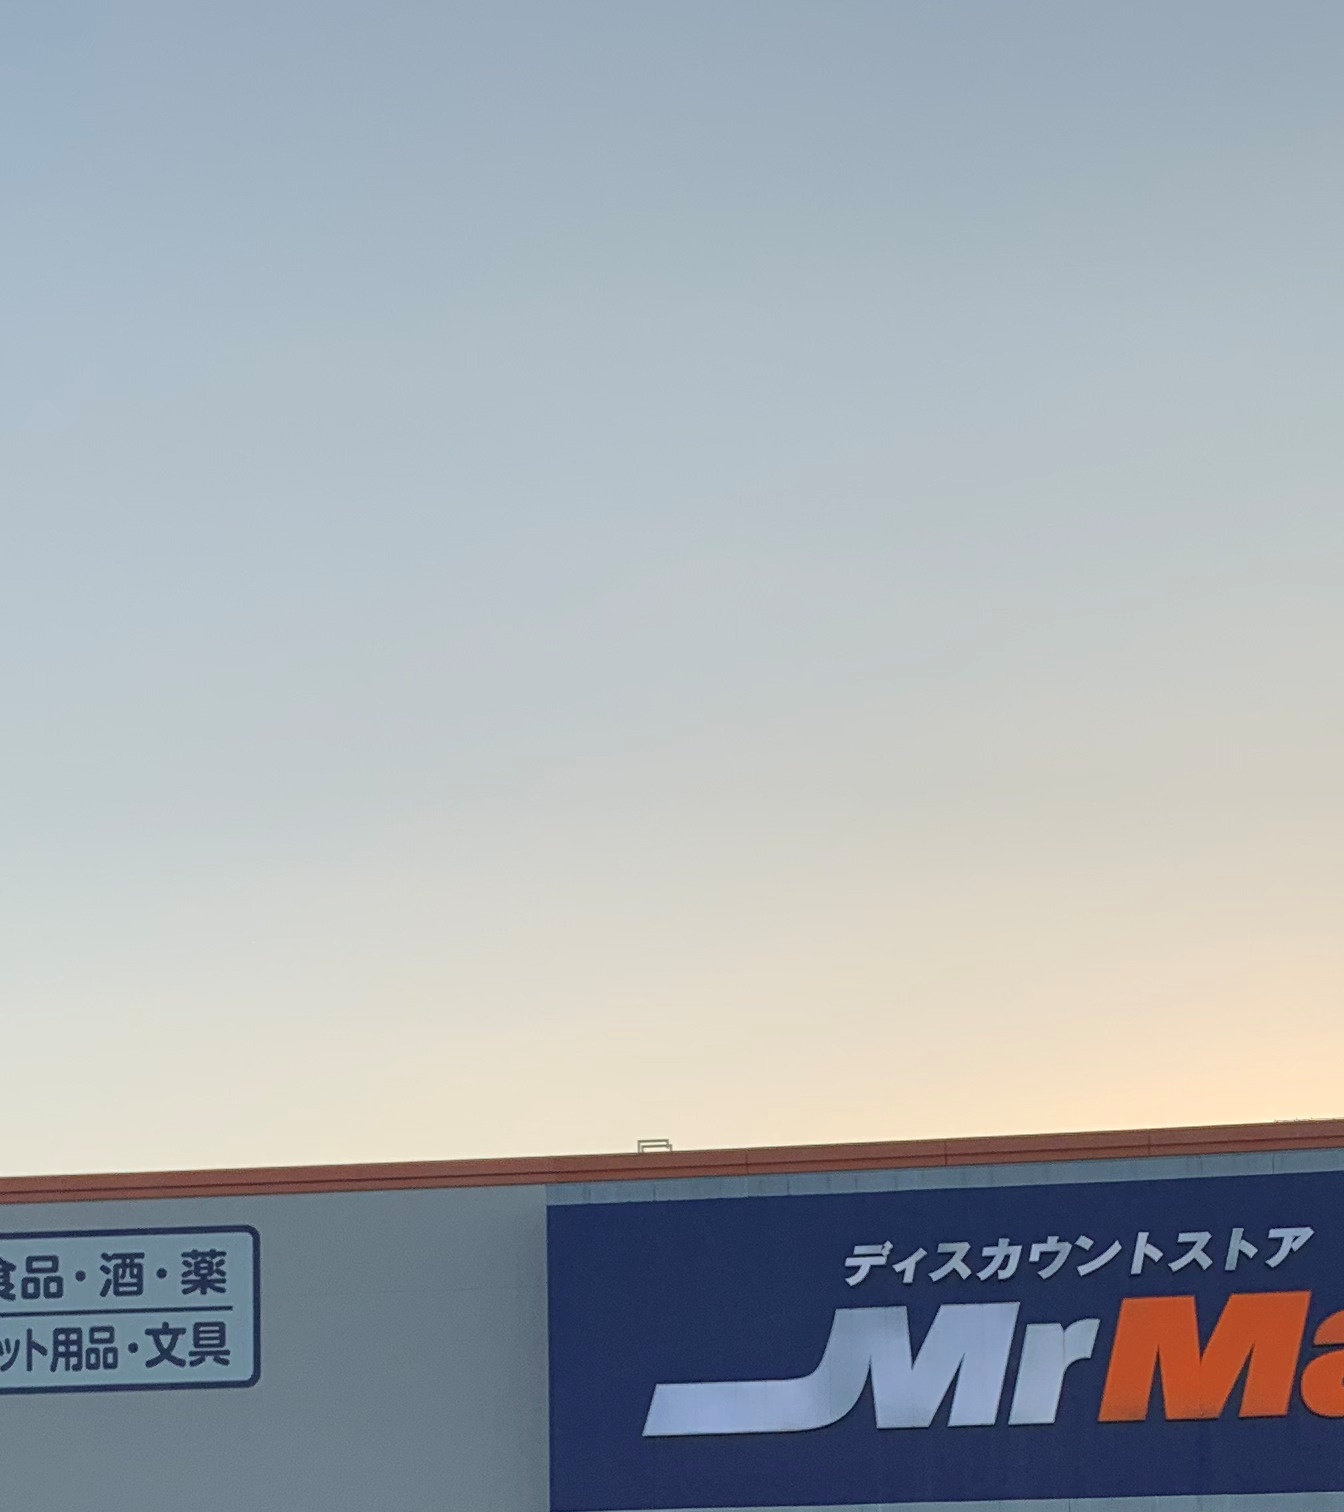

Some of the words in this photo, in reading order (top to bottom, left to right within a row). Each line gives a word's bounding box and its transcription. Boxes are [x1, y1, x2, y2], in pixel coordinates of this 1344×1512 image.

[843, 1226, 1314, 1286] ディスカウントストア
